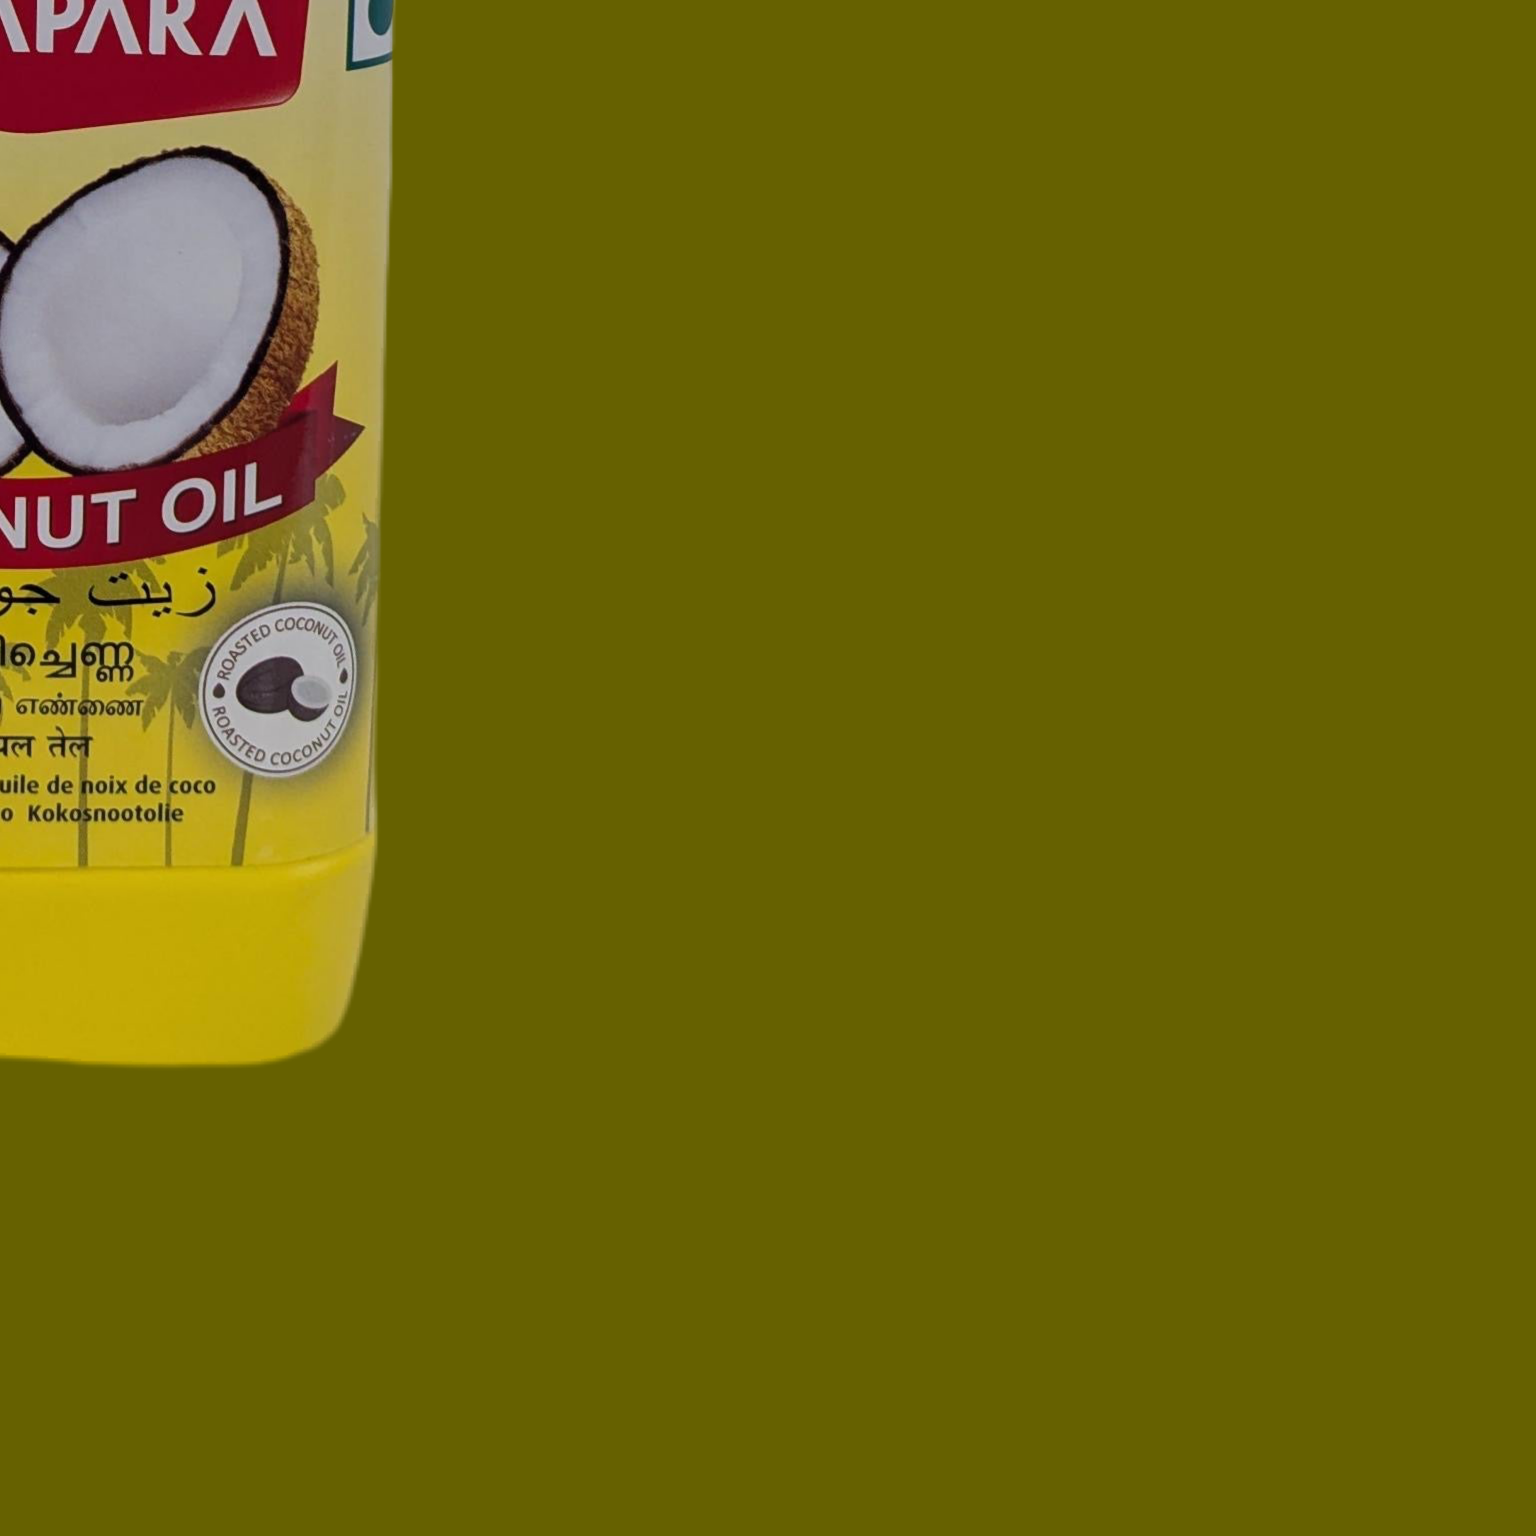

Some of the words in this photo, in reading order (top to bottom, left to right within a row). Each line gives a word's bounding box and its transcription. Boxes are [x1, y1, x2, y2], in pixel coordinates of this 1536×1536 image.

[160, 460, 283, 533] OIL
[88, 566, 217, 617] زيت
[217, 624, 271, 681] ROASTED
[274, 616, 338, 646] COCONUT
[332, 643, 346, 668] OIL
[46, 726, 94, 758] तेल
[212, 705, 266, 763] ROASTED
[270, 719, 337, 766] COCONUT
[333, 691, 348, 717] OIL
[47, 775, 73, 795] de
[81, 775, 127, 795] noix
[135, 775, 162, 795] de
[169, 779, 216, 795] coco
[28, 803, 184, 823] Kokosnootolie
